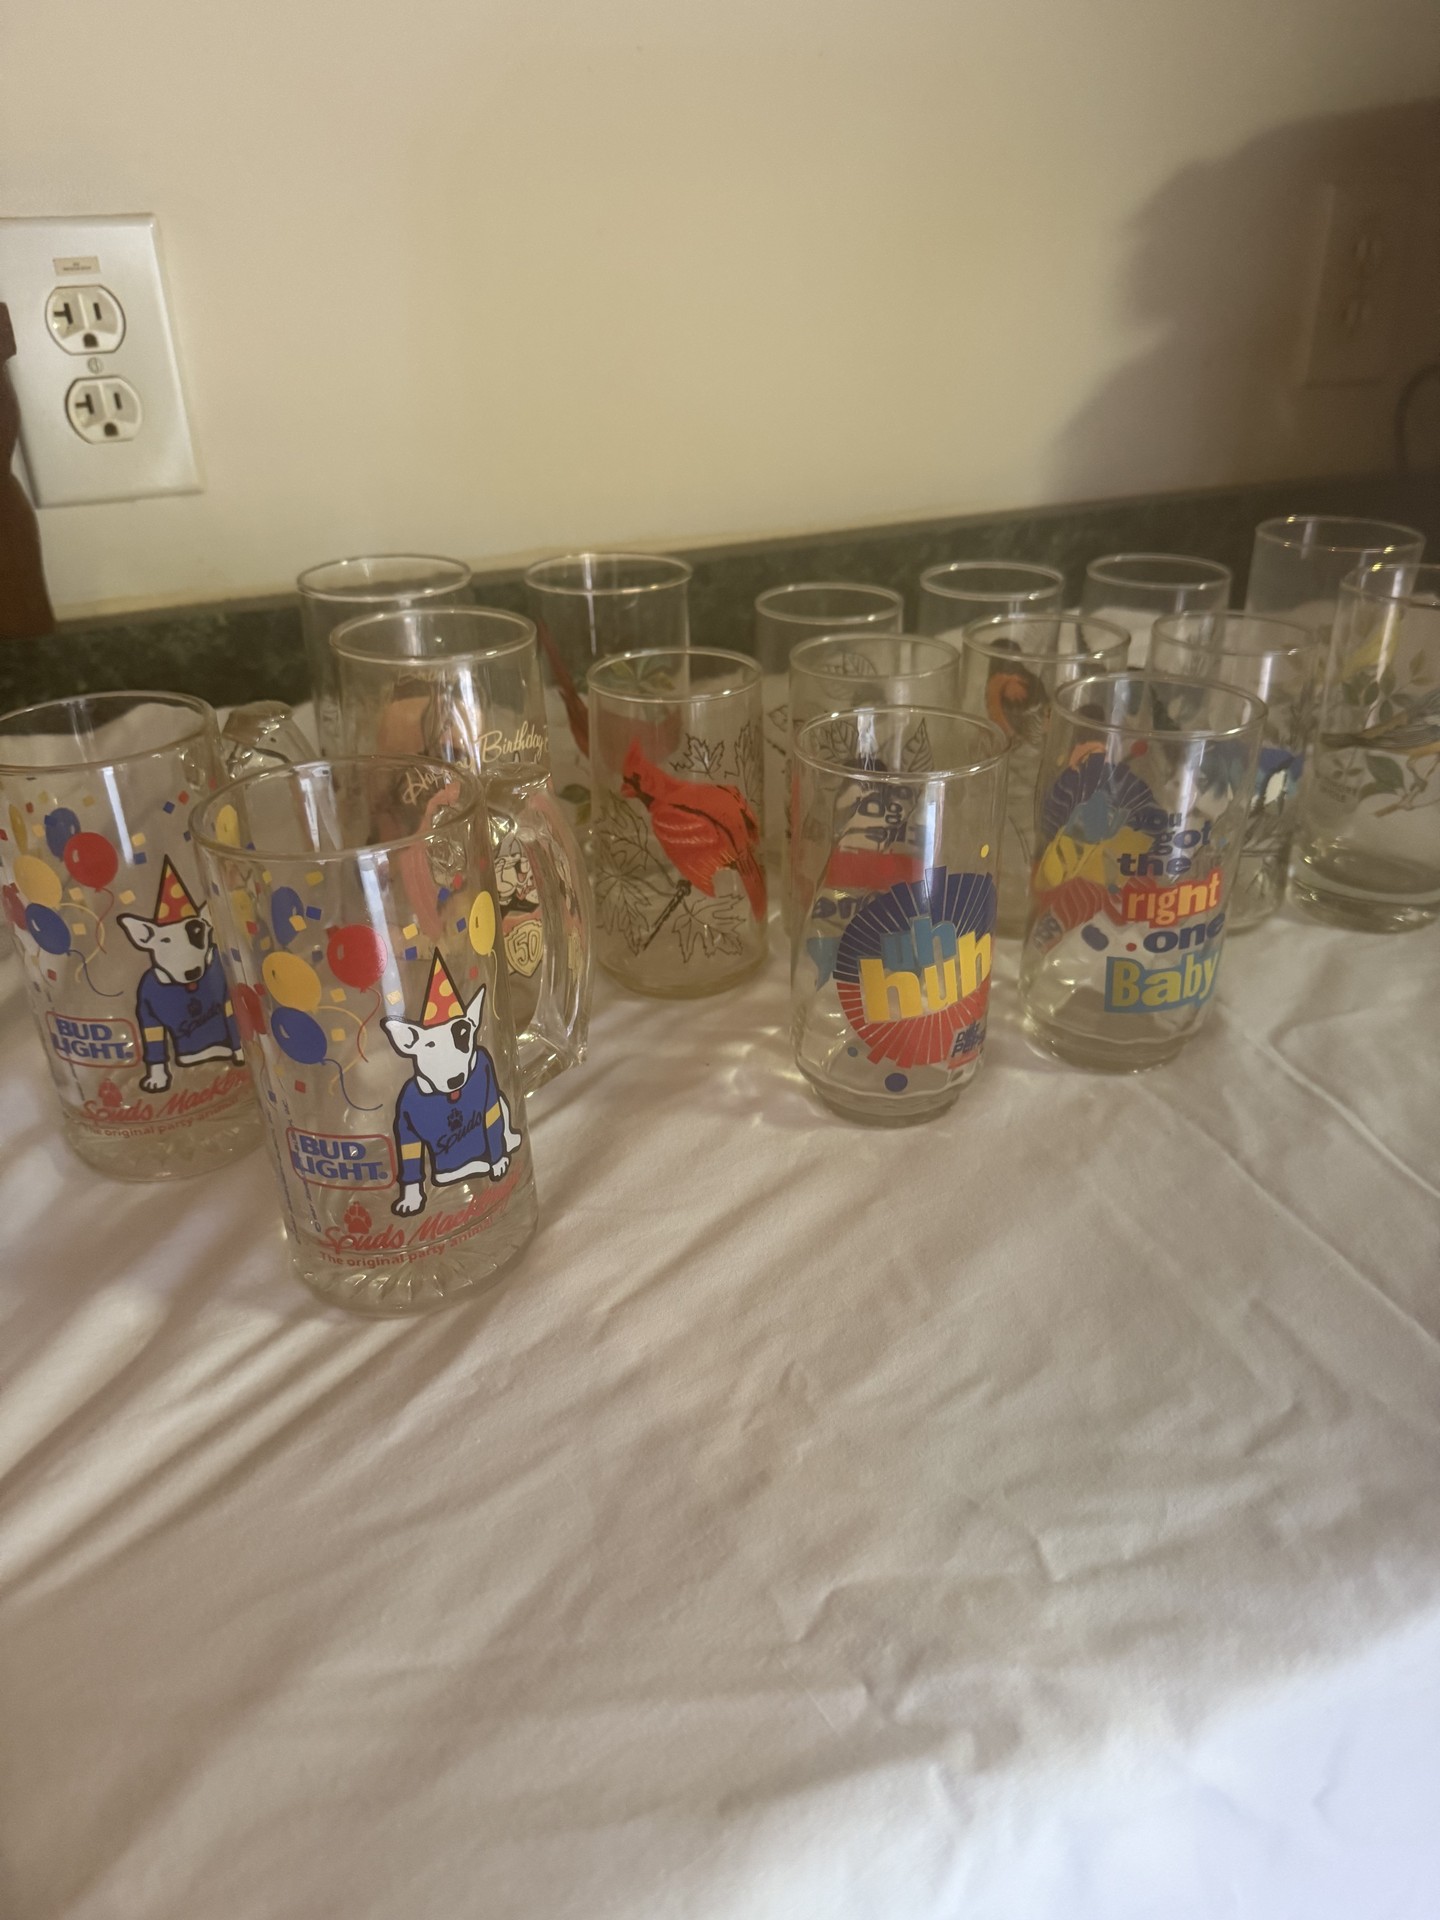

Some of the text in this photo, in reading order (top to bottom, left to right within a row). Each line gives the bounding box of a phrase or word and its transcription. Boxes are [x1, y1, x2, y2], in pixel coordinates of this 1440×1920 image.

[477, 720, 544, 763] Birthday
[1129, 810, 1183, 832] you
[1151, 820, 1212, 855] got
[1117, 852, 1192, 877] the
[1126, 872, 1220, 926] right
[1143, 912, 1226, 953] one
[514, 940, 536, 963] 50
[860, 931, 992, 1023] huh
[1111, 951, 1220, 1007] Baby
[55, 1017, 112, 1041] BUD
[104, 1127, 154, 1139] original
[159, 1119, 193, 1134] party
[436, 1109, 482, 1154] Spuds
[298, 1135, 366, 1160] BUD
[318, 1223, 405, 1255] Spuds
[320, 1252, 344, 1266] The
[346, 1252, 405, 1269] original
[408, 1242, 447, 1263] party
